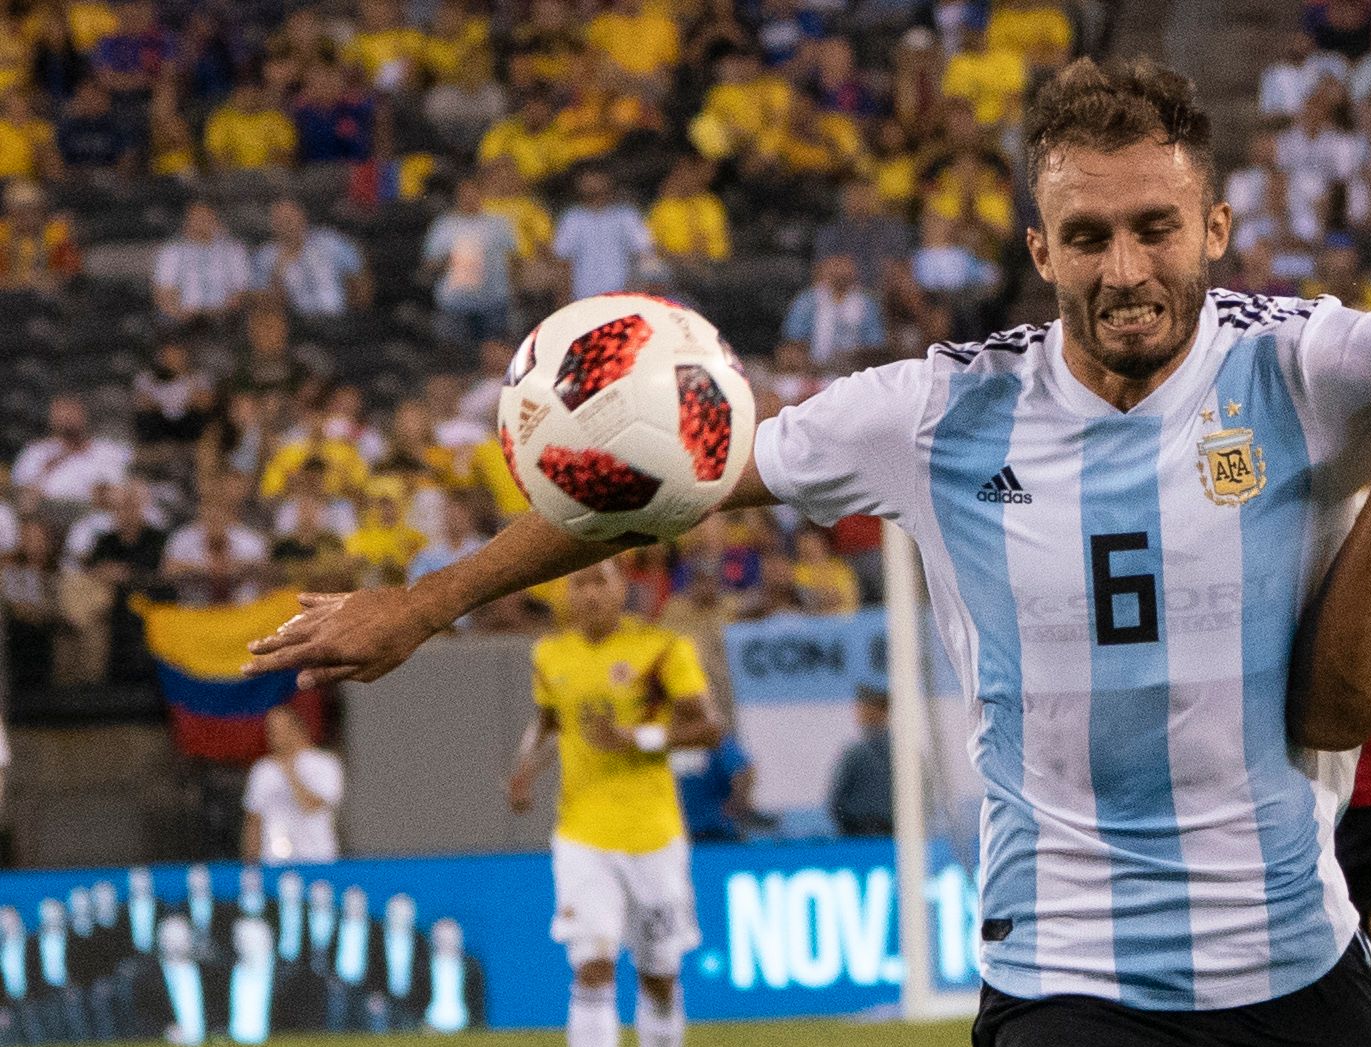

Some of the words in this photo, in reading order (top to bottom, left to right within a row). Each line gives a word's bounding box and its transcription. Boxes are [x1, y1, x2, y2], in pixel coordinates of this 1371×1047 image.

[976, 490, 1033, 504] adidas
[1216, 449, 1251, 483] AFA
[1090, 531, 1159, 645] 6
[727, 867, 907, 988] NOV.
